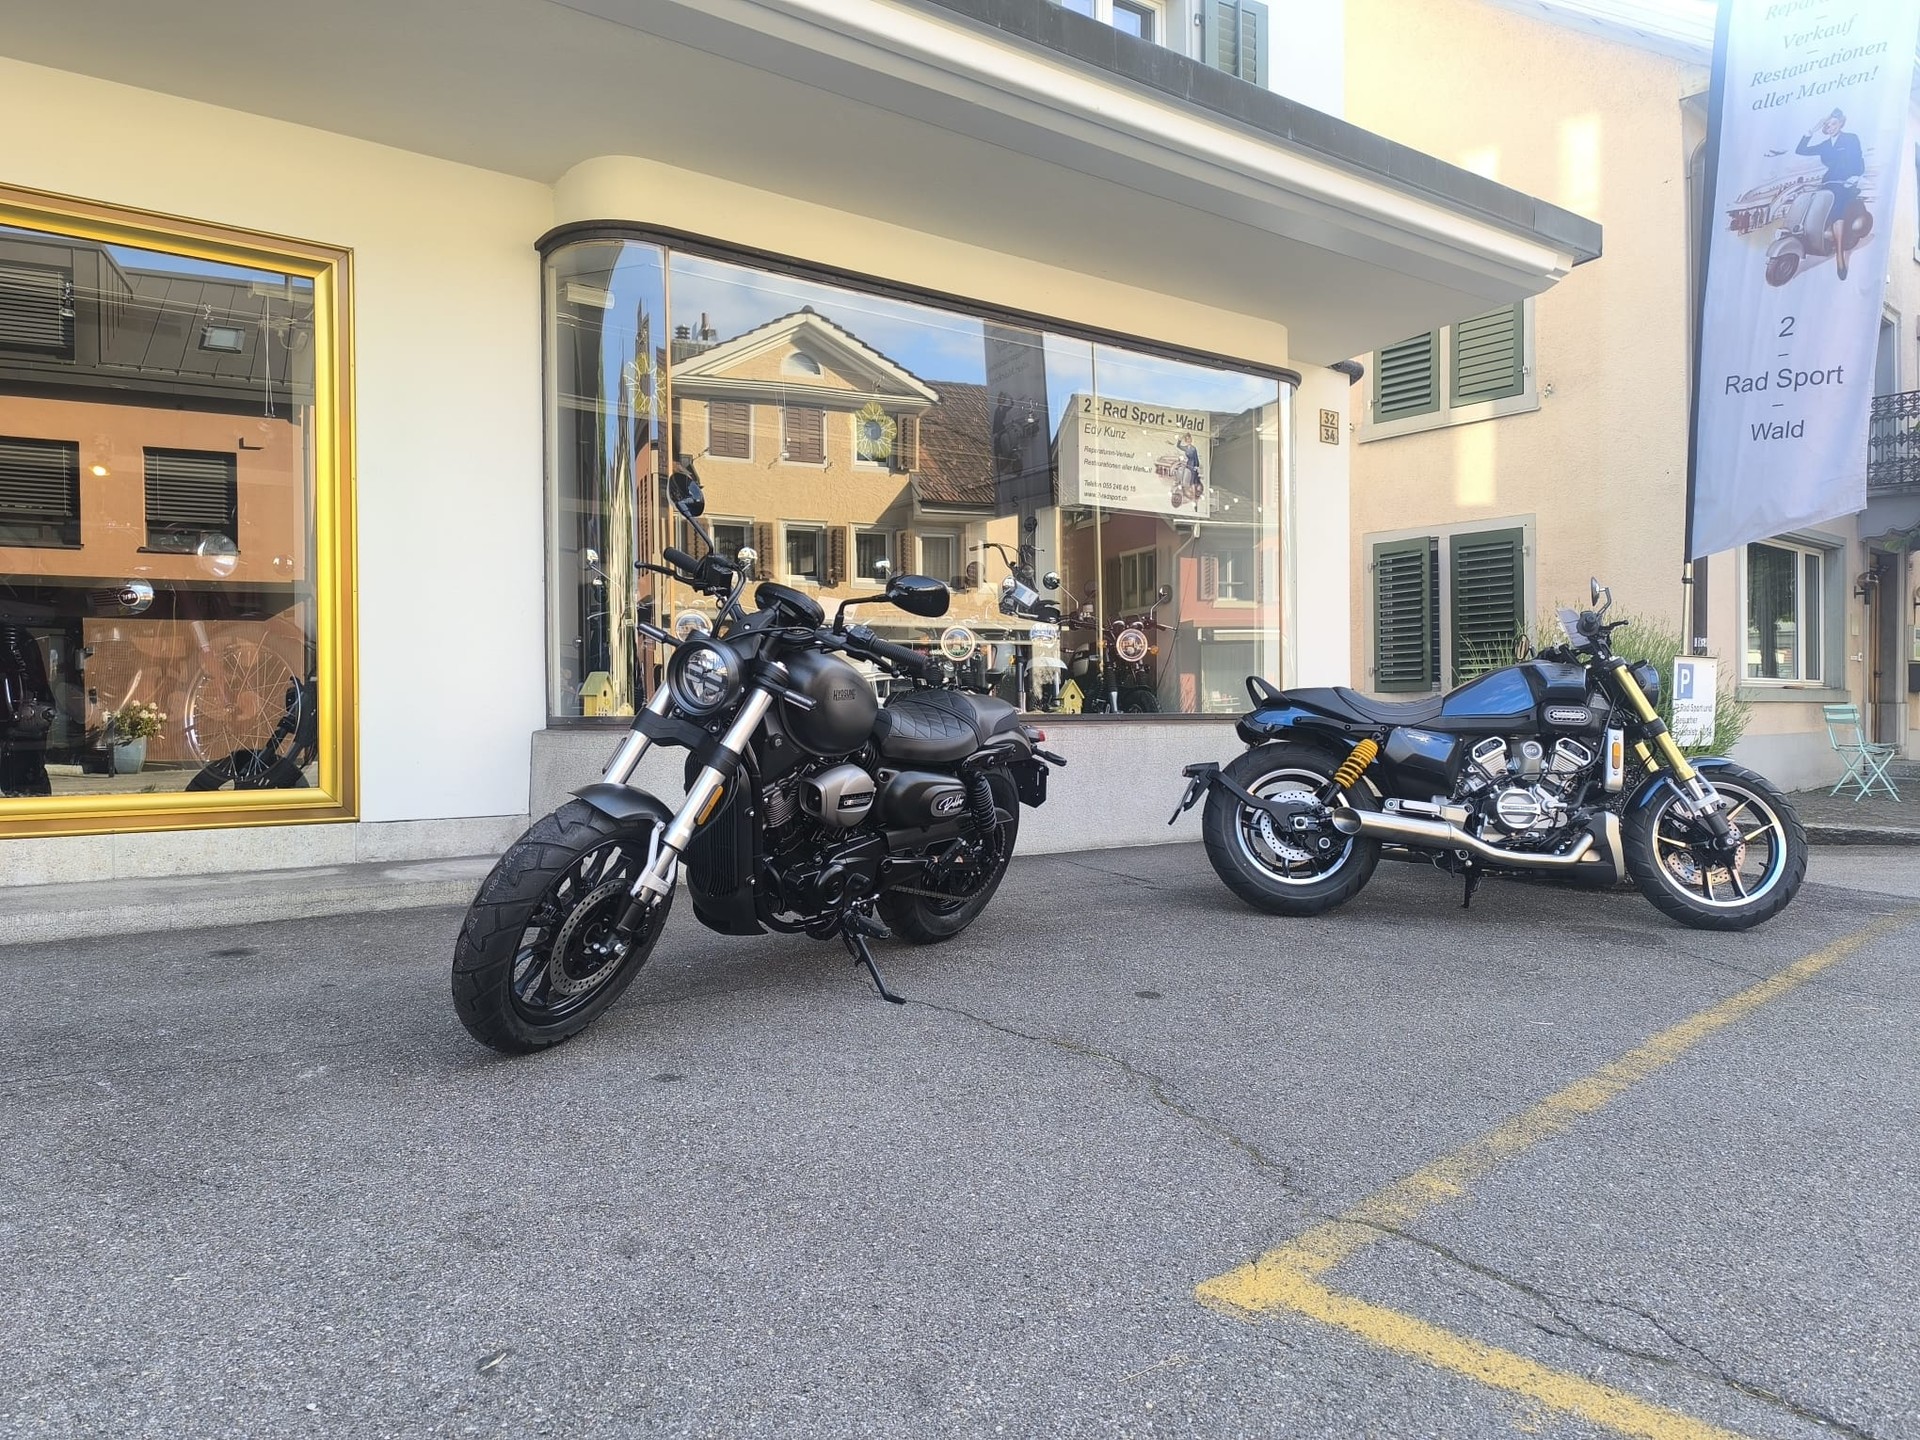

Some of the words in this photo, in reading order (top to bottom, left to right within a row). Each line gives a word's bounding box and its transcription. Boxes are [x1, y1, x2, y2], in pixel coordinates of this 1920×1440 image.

[1783, 13, 1859, 49] Verkauf
[1749, 40, 1888, 88] Restaurationen
[1752, 91, 1794, 111] aller
[1796, 65, 1879, 100] Marken!
[1778, 316, 1795, 338] 2
[1725, 371, 1769, 395] Rad
[1776, 365, 1844, 392] Sport
[1084, 398, 1091, 413] 2
[1102, 401, 1128, 419] Rad
[1131, 406, 1165, 425] Sport
[1176, 413, 1205, 432] Wald
[1324, 411, 1336, 426] 32
[1084, 422, 1102, 437] Edy
[1104, 426, 1126, 440] Kunz
[1324, 428, 1336, 442] 34
[1751, 419, 1805, 441] Wald
[1680, 668, 1690, 694] P
